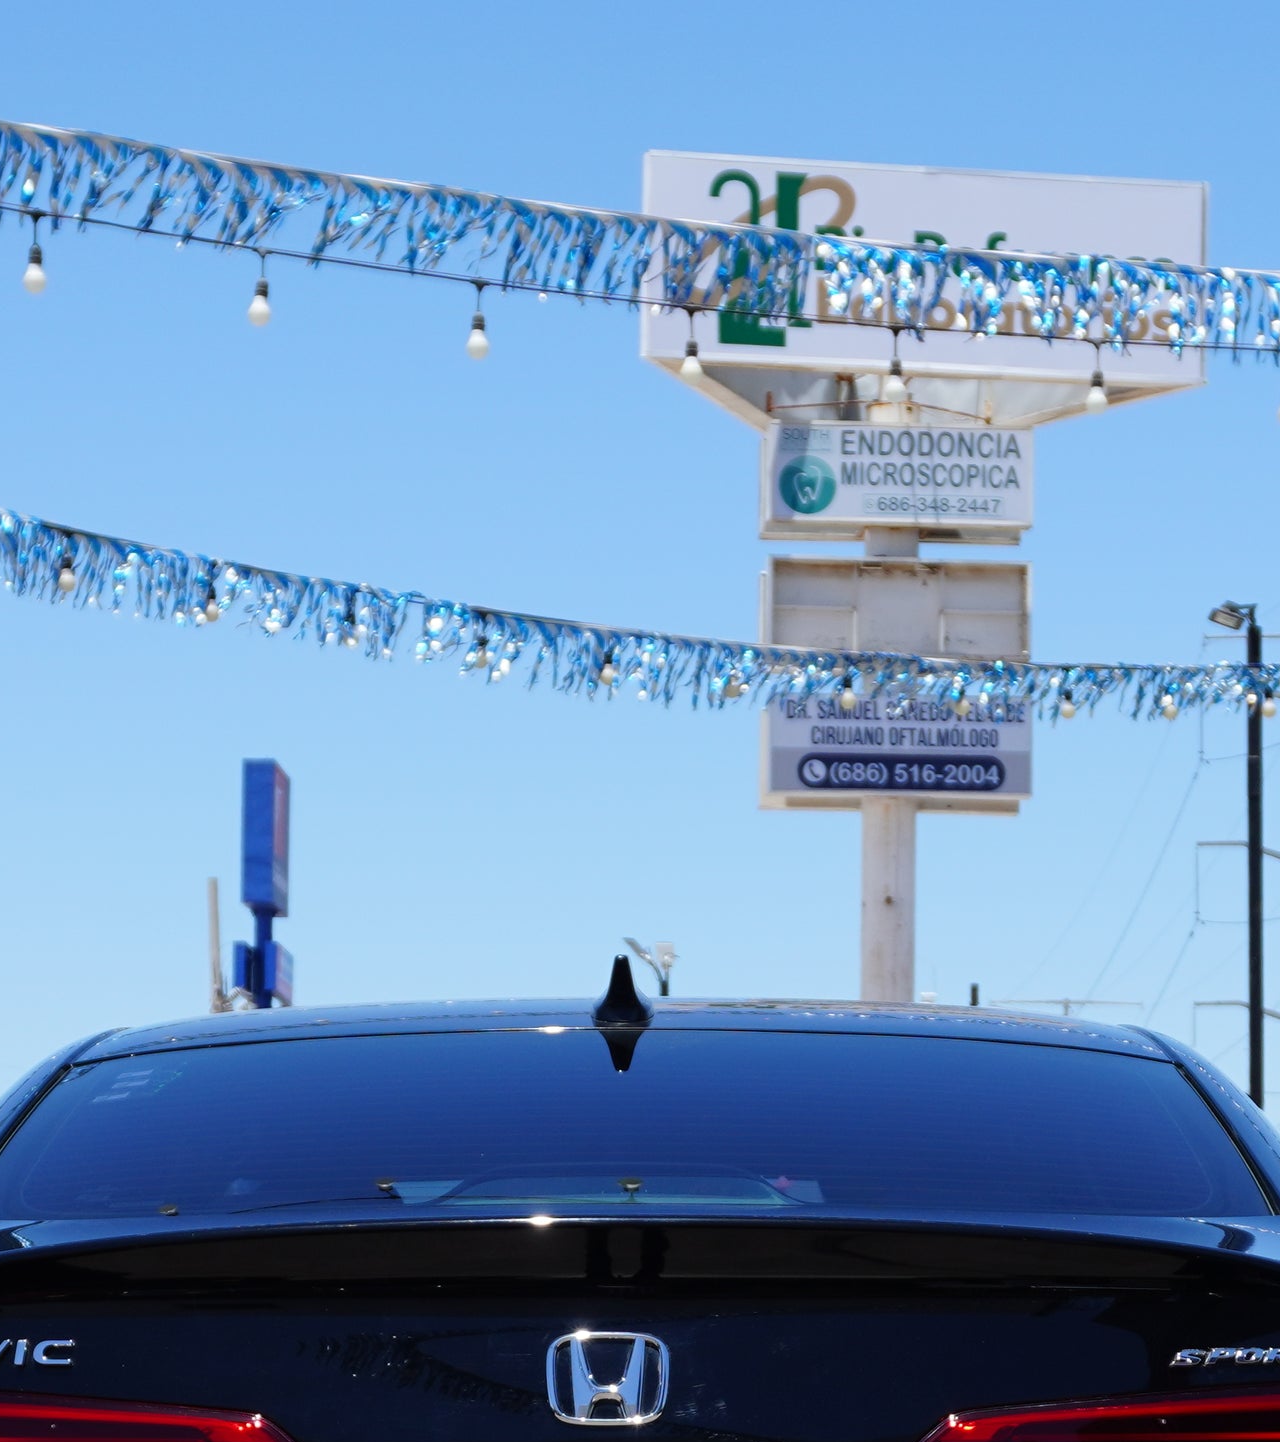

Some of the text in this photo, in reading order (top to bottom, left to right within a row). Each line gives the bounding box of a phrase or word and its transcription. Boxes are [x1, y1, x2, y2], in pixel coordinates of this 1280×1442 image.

[841, 430, 1021, 459] ENDODONCIA
[841, 462, 1020, 488] MICROSCOPICA
[877, 496, 1001, 513] 686-348-2447
[811, 725, 999, 748] CIRUJANO OFTALMÓLOGO
[830, 762, 1000, 784] (686) 516-2004
